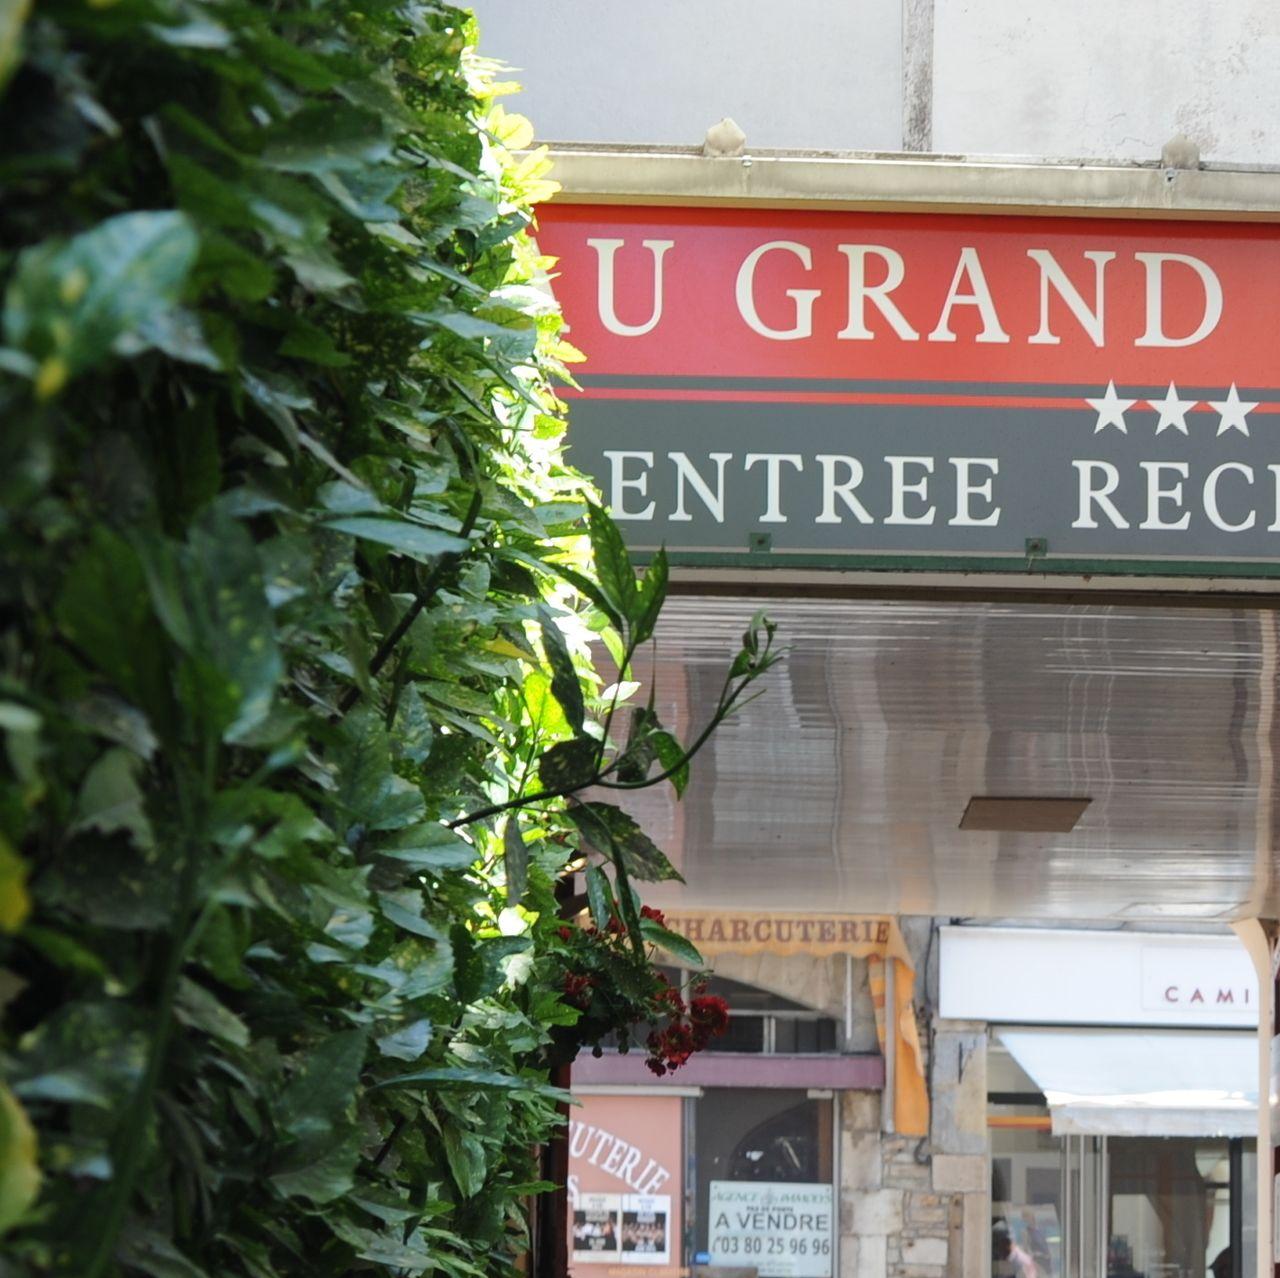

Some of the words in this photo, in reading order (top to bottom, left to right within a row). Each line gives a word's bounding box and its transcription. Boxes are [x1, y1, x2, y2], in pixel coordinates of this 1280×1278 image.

[735, 240, 1224, 348] GRAND
[602, 449, 1002, 527] ENTREE
[1164, 985, 1250, 1005] CAMI
[568, 1119, 671, 1197] UTERIE
[714, 1212, 731, 1230] A
[735, 1212, 830, 1232] VENDRE
[721, 1236, 739, 1254] 03
[743, 1236, 762, 1254] 80
[767, 1236, 785, 1255] 25
[789, 1237, 808, 1255] 96
[812, 1237, 831, 1256] 96
